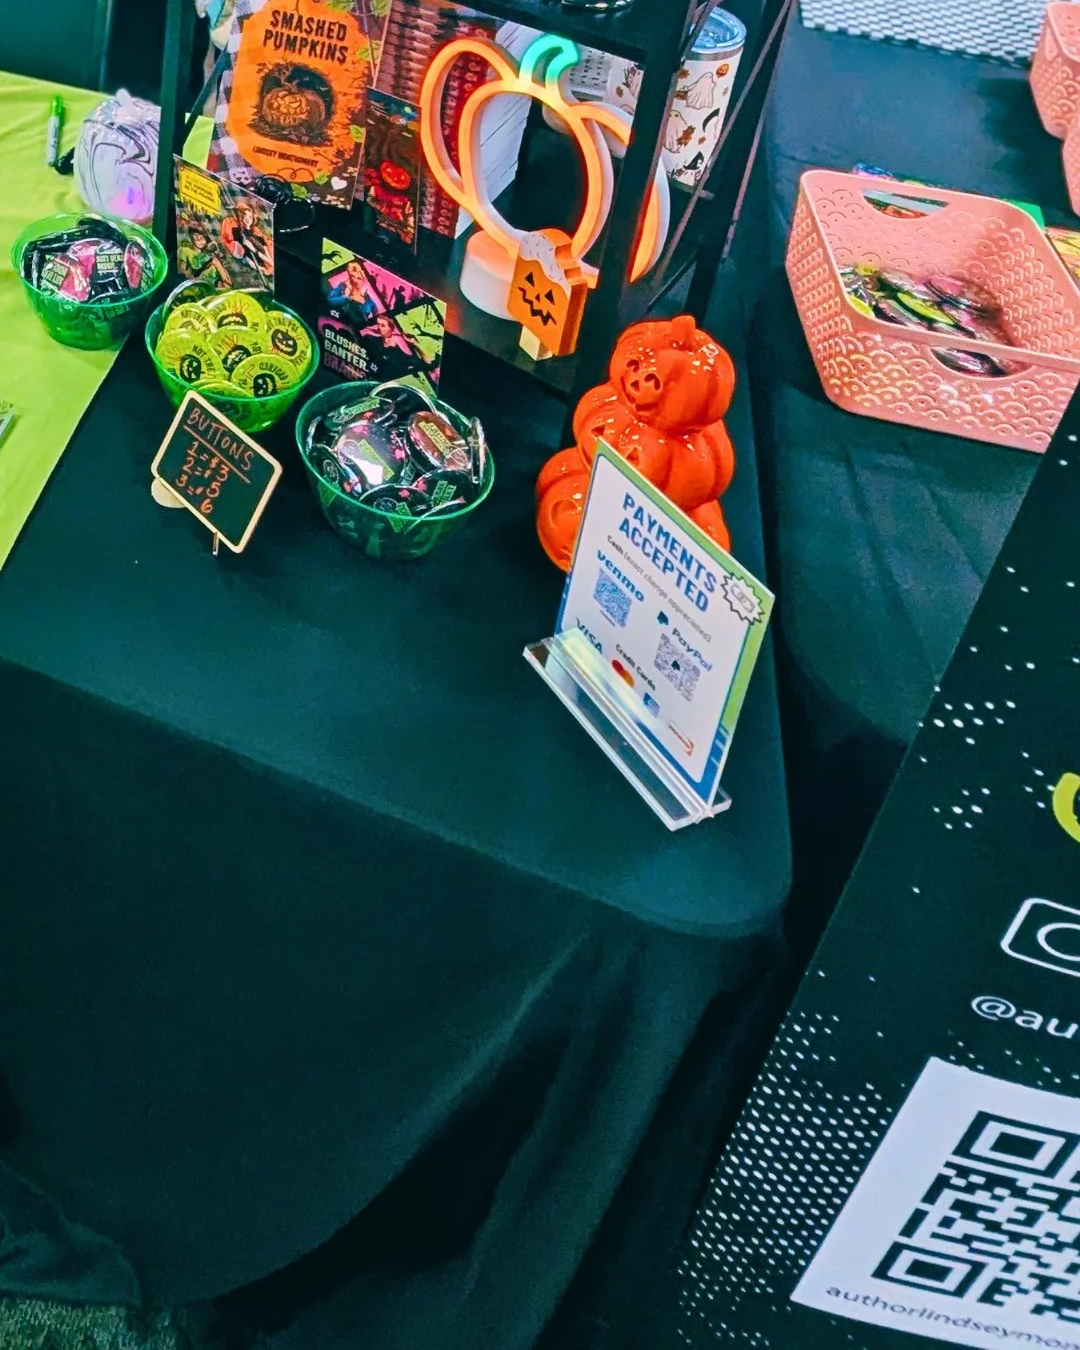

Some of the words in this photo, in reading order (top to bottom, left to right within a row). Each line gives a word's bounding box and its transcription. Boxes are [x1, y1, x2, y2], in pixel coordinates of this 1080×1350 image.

[262, 29, 349, 65] PUMPKINS
[270, 9, 348, 43] SMASHED
[324, 328, 370, 360] BLUSHES.
[324, 339, 369, 372] BANTER.
[187, 408, 255, 471] BUTTONS
[618, 517, 709, 613] ACCEPTED
[622, 492, 718, 594] PAYMENTS
[597, 549, 646, 602] venmo
[607, 534, 624, 556] Cash
[623, 551, 644, 576] (exact
[643, 572, 669, 601] change
[574, 615, 604, 652] VISA
[672, 627, 714, 671] PayPal
